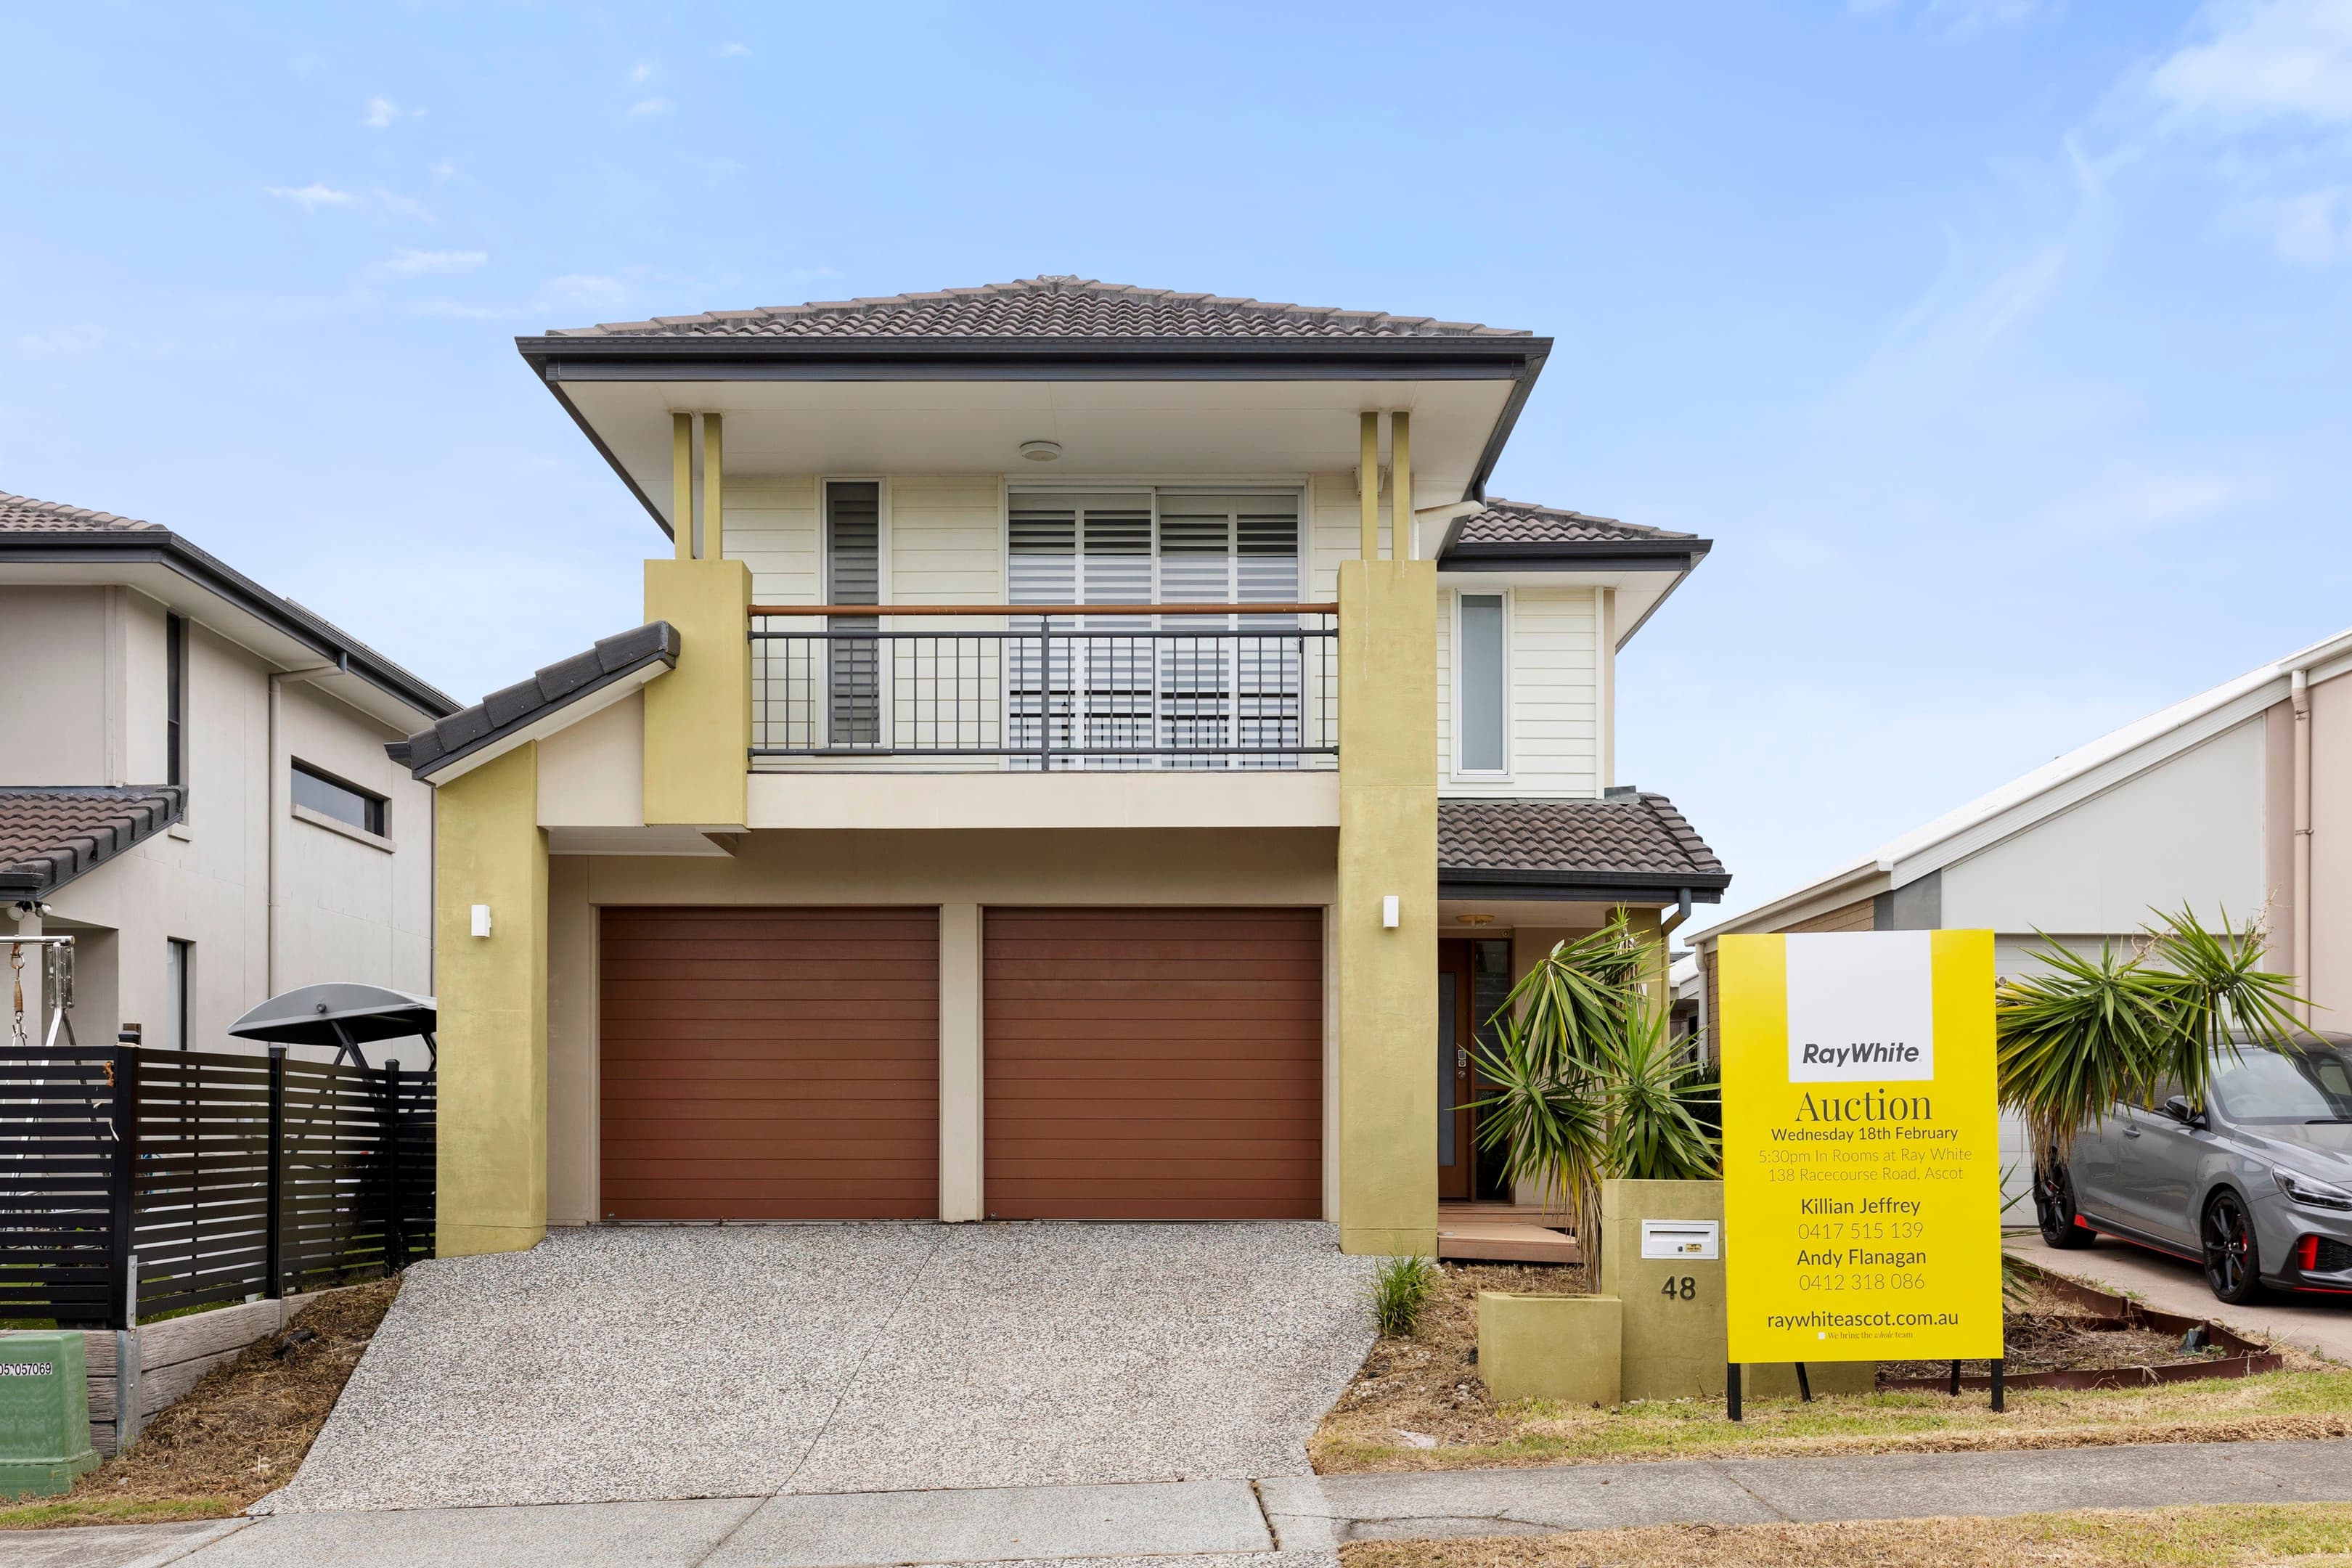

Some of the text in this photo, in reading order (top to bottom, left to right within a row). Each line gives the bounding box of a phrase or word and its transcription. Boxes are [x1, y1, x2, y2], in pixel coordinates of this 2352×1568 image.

[1795, 1088, 1932, 1122] Auction
[1771, 1127, 1958, 1143] Wednesday 18th February
[1760, 1148, 1972, 1164] 5:30pm In Rooms at Ray White
[1769, 1167, 1963, 1181] 138 Racecourse Road, Ascot
[1802, 1197, 1920, 1216] Killian Jeffrey
[1799, 1222, 1923, 1239] 0417 515 139
[1797, 1249, 1926, 1268] Andy Flanagan
[1661, 1275, 1696, 1300] 48
[1800, 1273, 1924, 1290] 0412 318 086
[1768, 1311, 1958, 1331] raywhiteascot.com.au
[1840, 1331, 1860, 1341] bring
